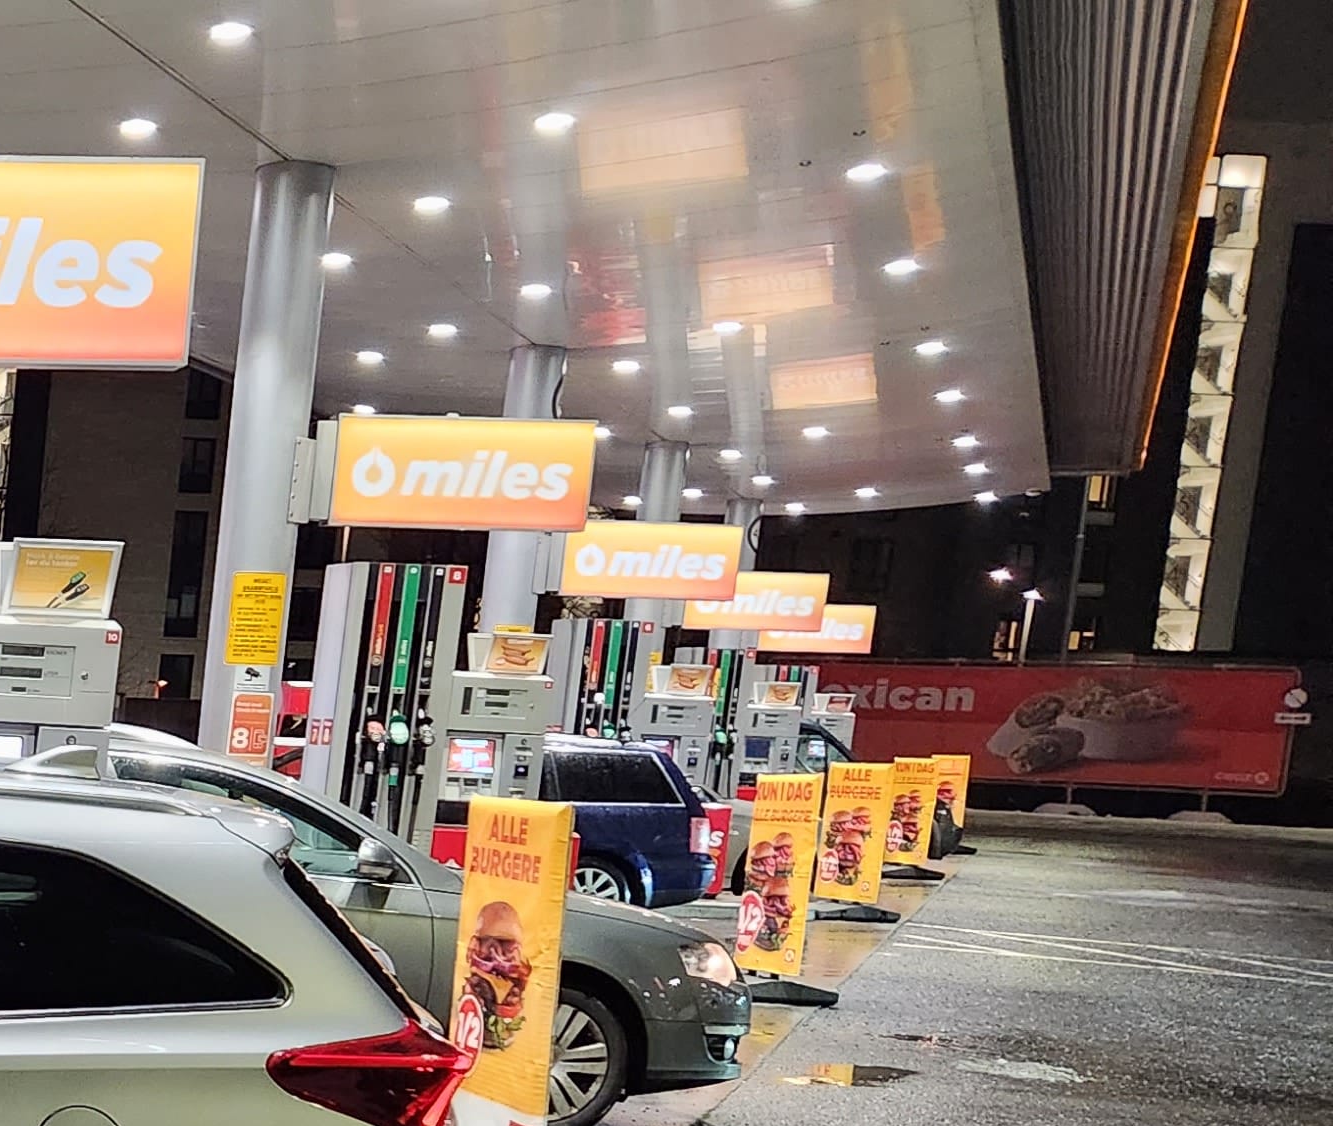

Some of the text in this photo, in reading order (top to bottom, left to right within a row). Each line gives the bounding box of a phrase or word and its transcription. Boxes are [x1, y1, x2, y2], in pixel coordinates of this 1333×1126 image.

[400, 449, 573, 502] miles
[452, 569, 461, 582] 8
[608, 545, 727, 581] miles
[722, 589, 816, 617] miles
[108, 632, 118, 642] 10
[231, 727, 250, 749] 8
[842, 768, 874, 783] ALLE
[786, 782, 814, 801] DAG
[830, 786, 882, 801] BURGERE
[489, 813, 530, 846] ALLE
[469, 845, 542, 885] BURGERE
[456, 1010, 482, 1049] 1/2
